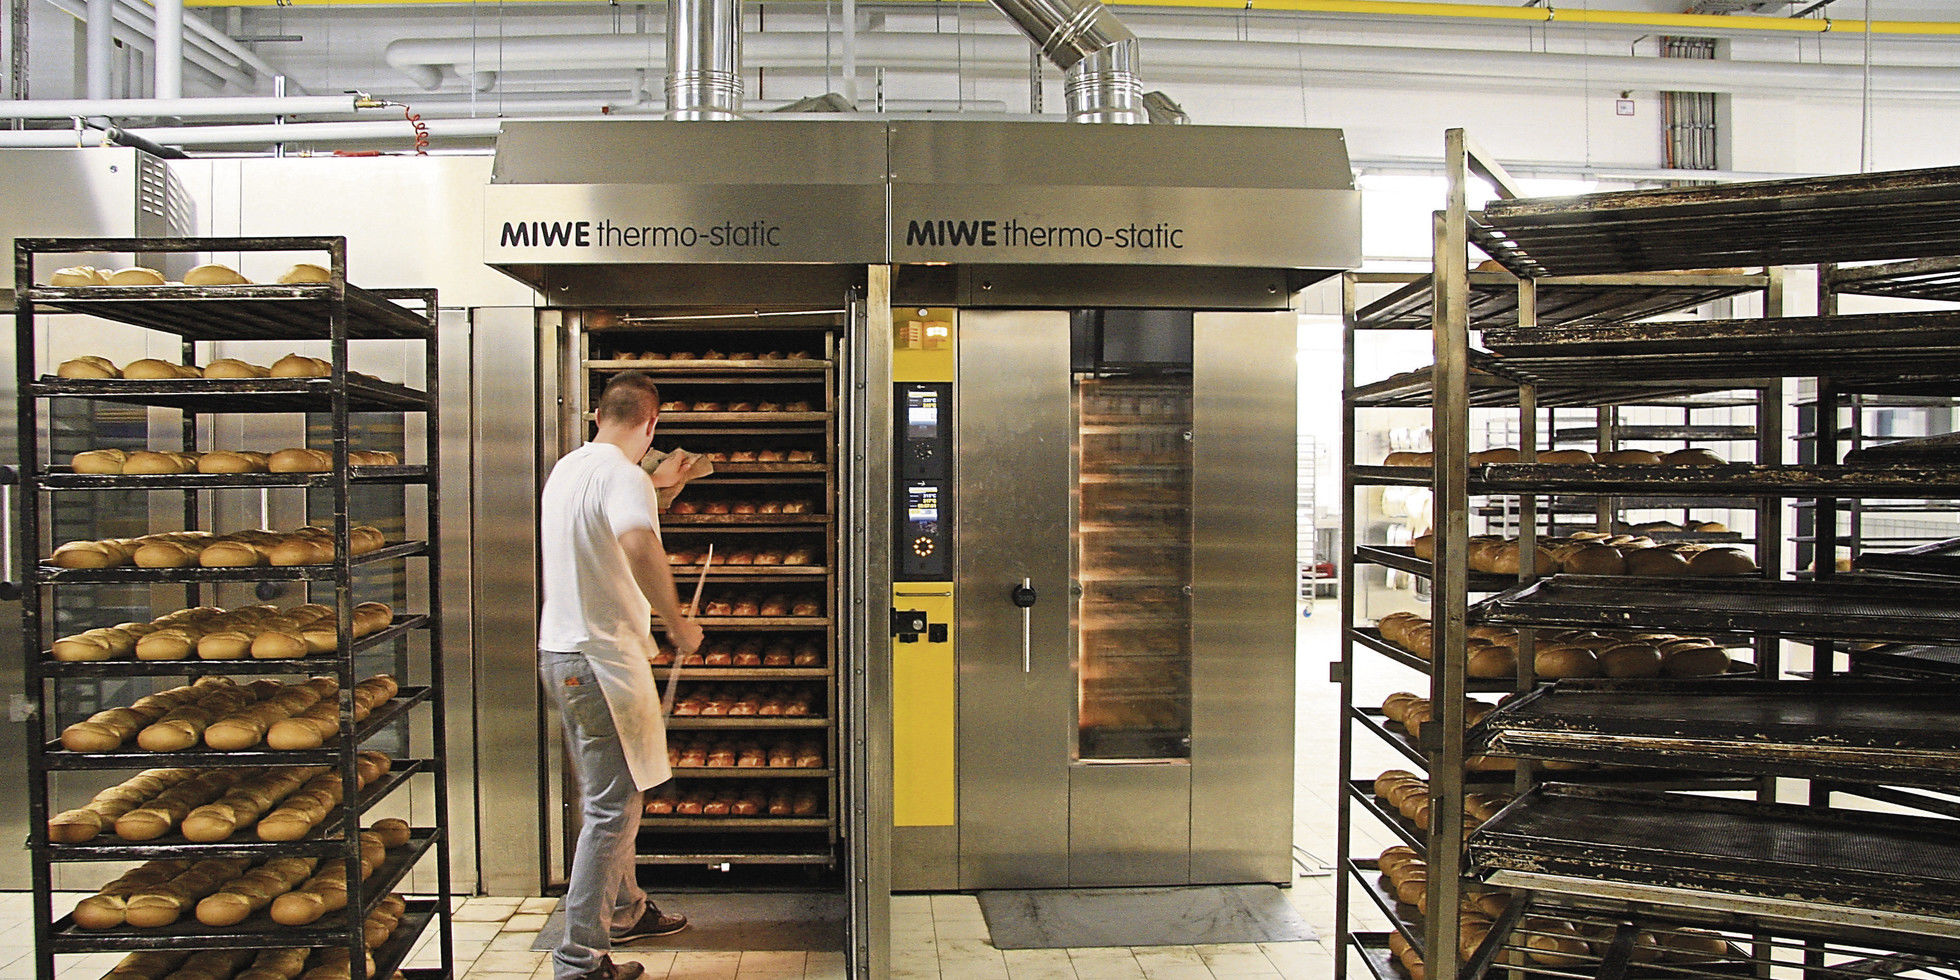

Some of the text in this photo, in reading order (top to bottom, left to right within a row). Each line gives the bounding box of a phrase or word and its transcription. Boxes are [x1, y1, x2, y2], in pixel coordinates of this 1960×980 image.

[500, 219, 780, 247] MIWE thermo-static
[906, 219, 1184, 248] MIWE thermo-static
